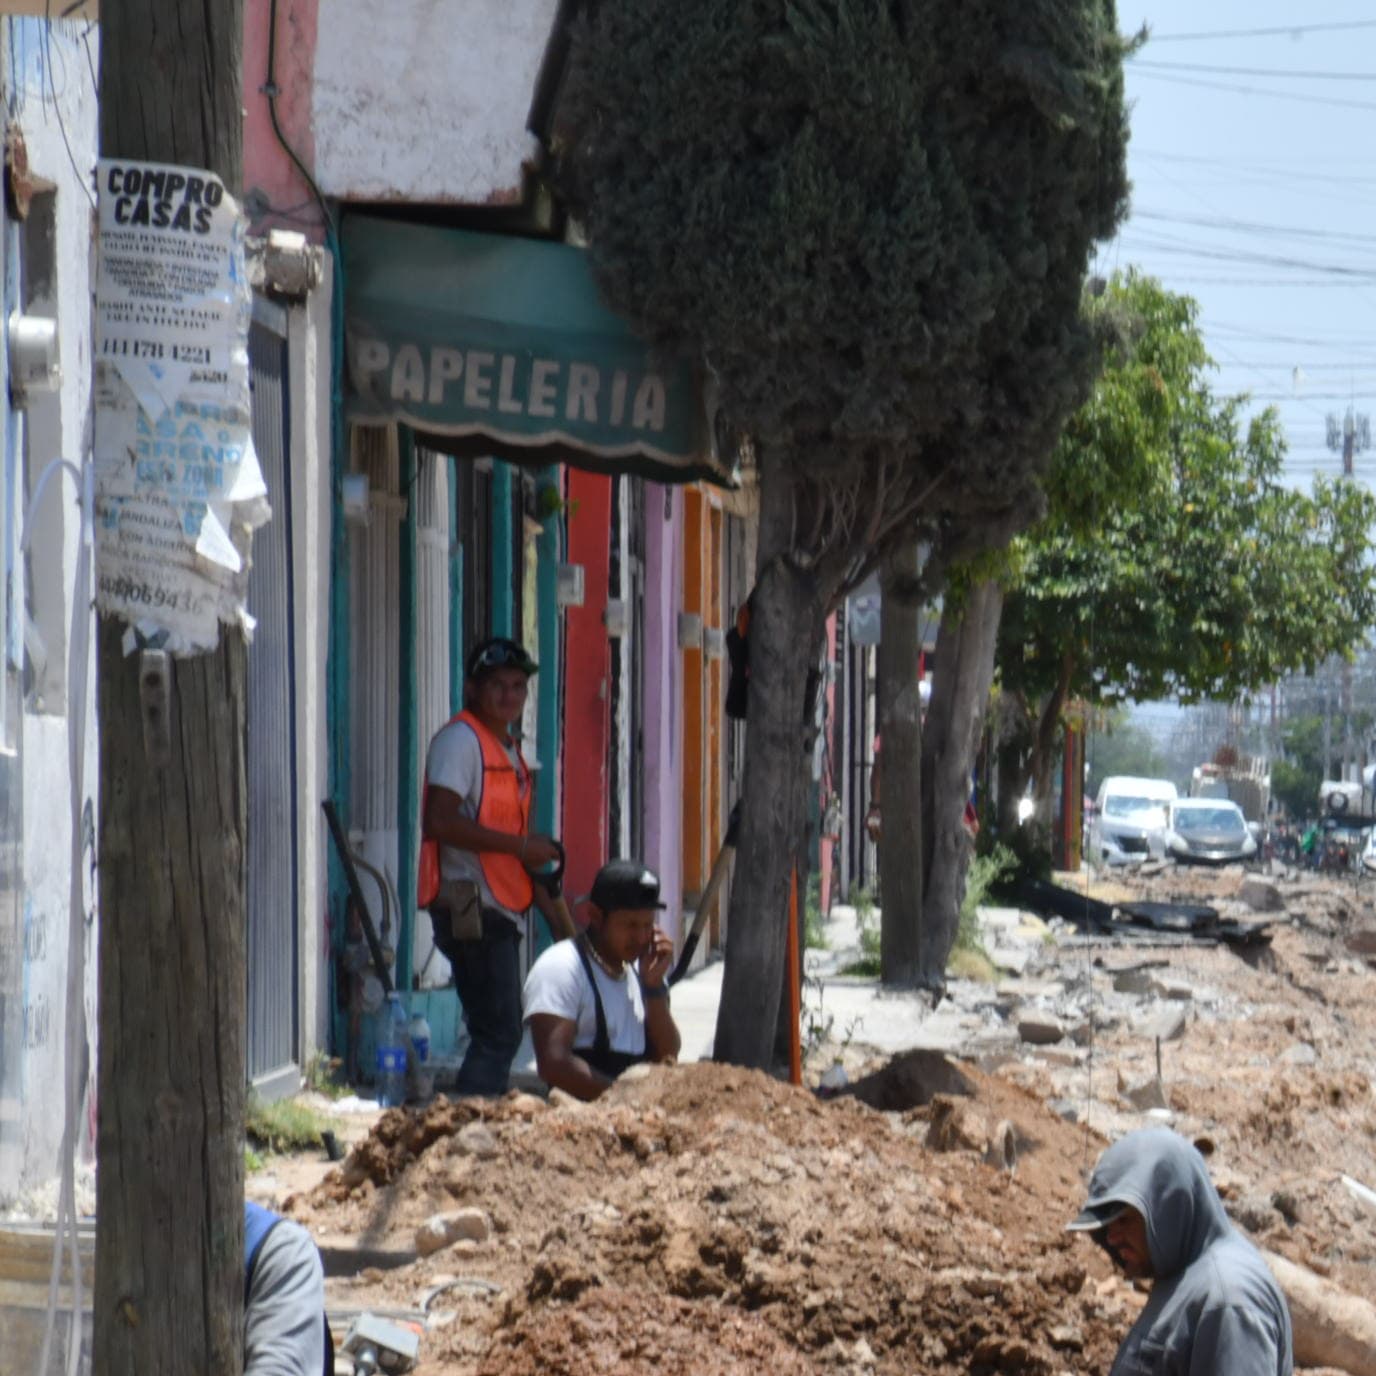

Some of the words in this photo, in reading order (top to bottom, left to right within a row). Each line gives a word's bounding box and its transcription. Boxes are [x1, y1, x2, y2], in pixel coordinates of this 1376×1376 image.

[108, 166, 224, 208] COMPRO
[114, 196, 213, 235] CASAS
[354, 339, 667, 432] PAPELERIA
